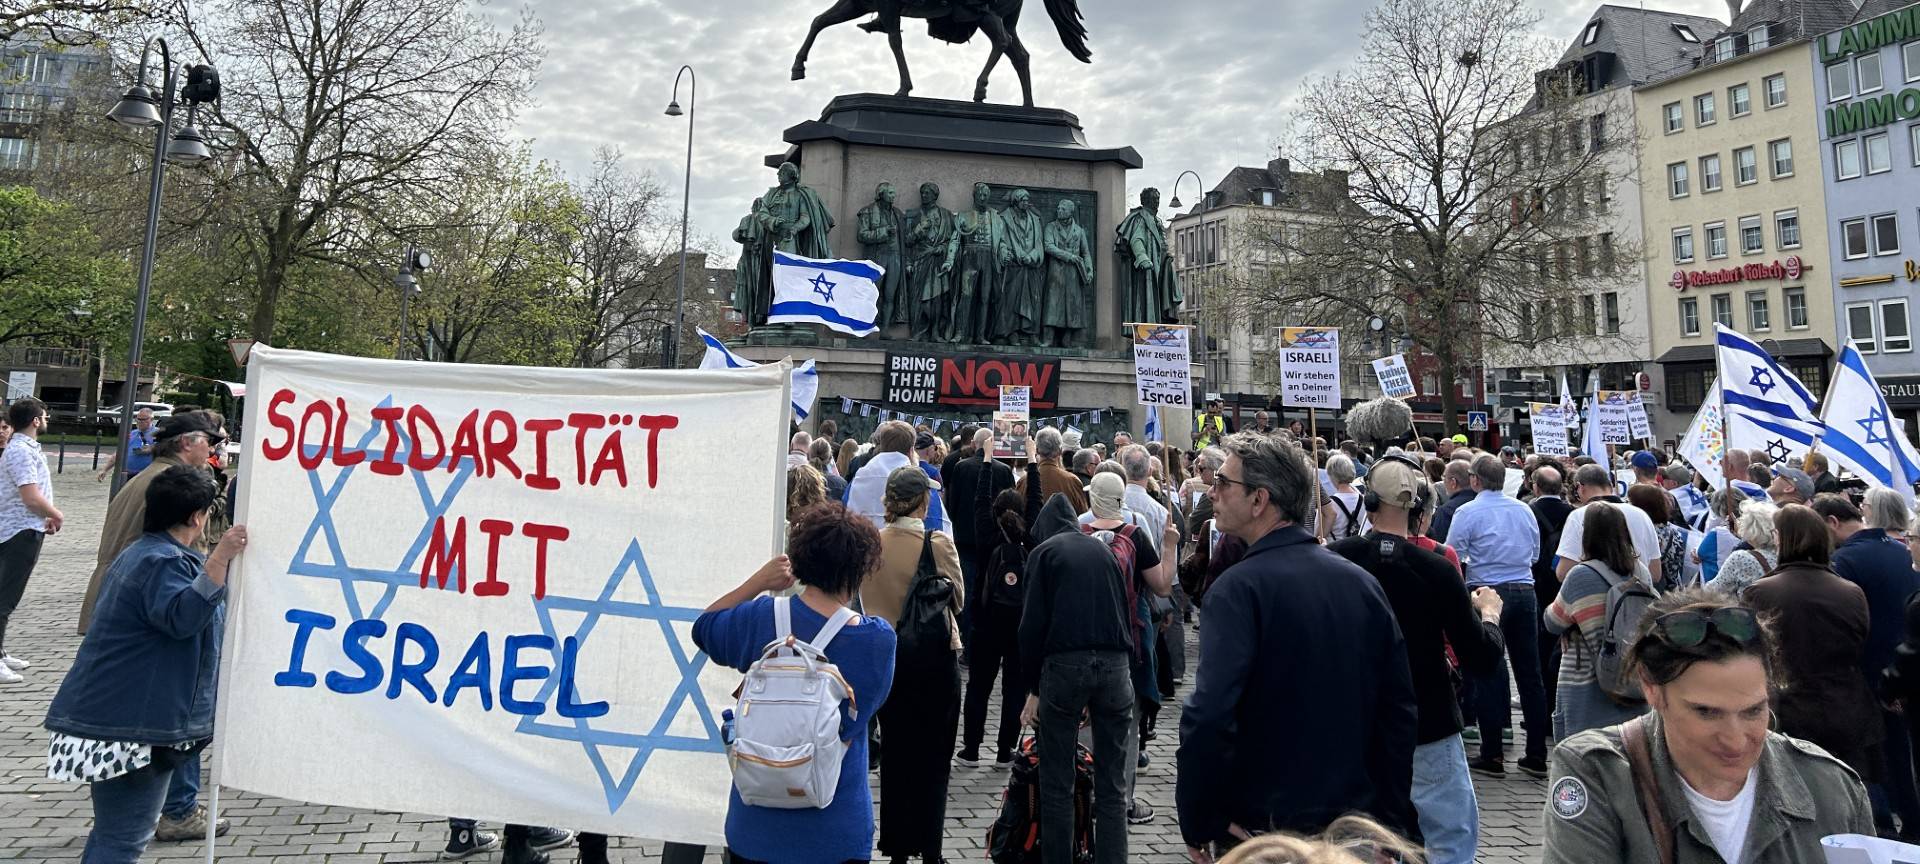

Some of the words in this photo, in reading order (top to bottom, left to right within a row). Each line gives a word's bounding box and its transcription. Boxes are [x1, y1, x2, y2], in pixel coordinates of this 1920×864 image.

[1688, 267, 1742, 287] Reissdorf
[1743, 260, 1784, 280] Kölsch
[1136, 348, 1152, 358] Wir
[1154, 350, 1186, 361] zeigen:
[1286, 352, 1332, 363] ISRAEL!
[891, 356, 937, 372] BRING
[941, 358, 1054, 399] NOW
[1137, 367, 1188, 379] Solidarität
[1285, 371, 1301, 379] Wir
[1304, 371, 1335, 380] stehen
[1379, 367, 1407, 379] BRING
[890, 372, 936, 388] THEM
[1384, 376, 1409, 389] THEM
[1302, 383, 1332, 391] Deiner
[889, 388, 935, 403] HOME
[1141, 388, 1187, 405] Israel
[1294, 394, 1328, 403] Seite!!!
[262, 388, 679, 490] SOLIDARITÄT
[1602, 432, 1627, 443] Israel
[1537, 444, 1567, 455] Israel
[419, 515, 570, 600] MIT
[274, 609, 610, 718] ISRAEL
